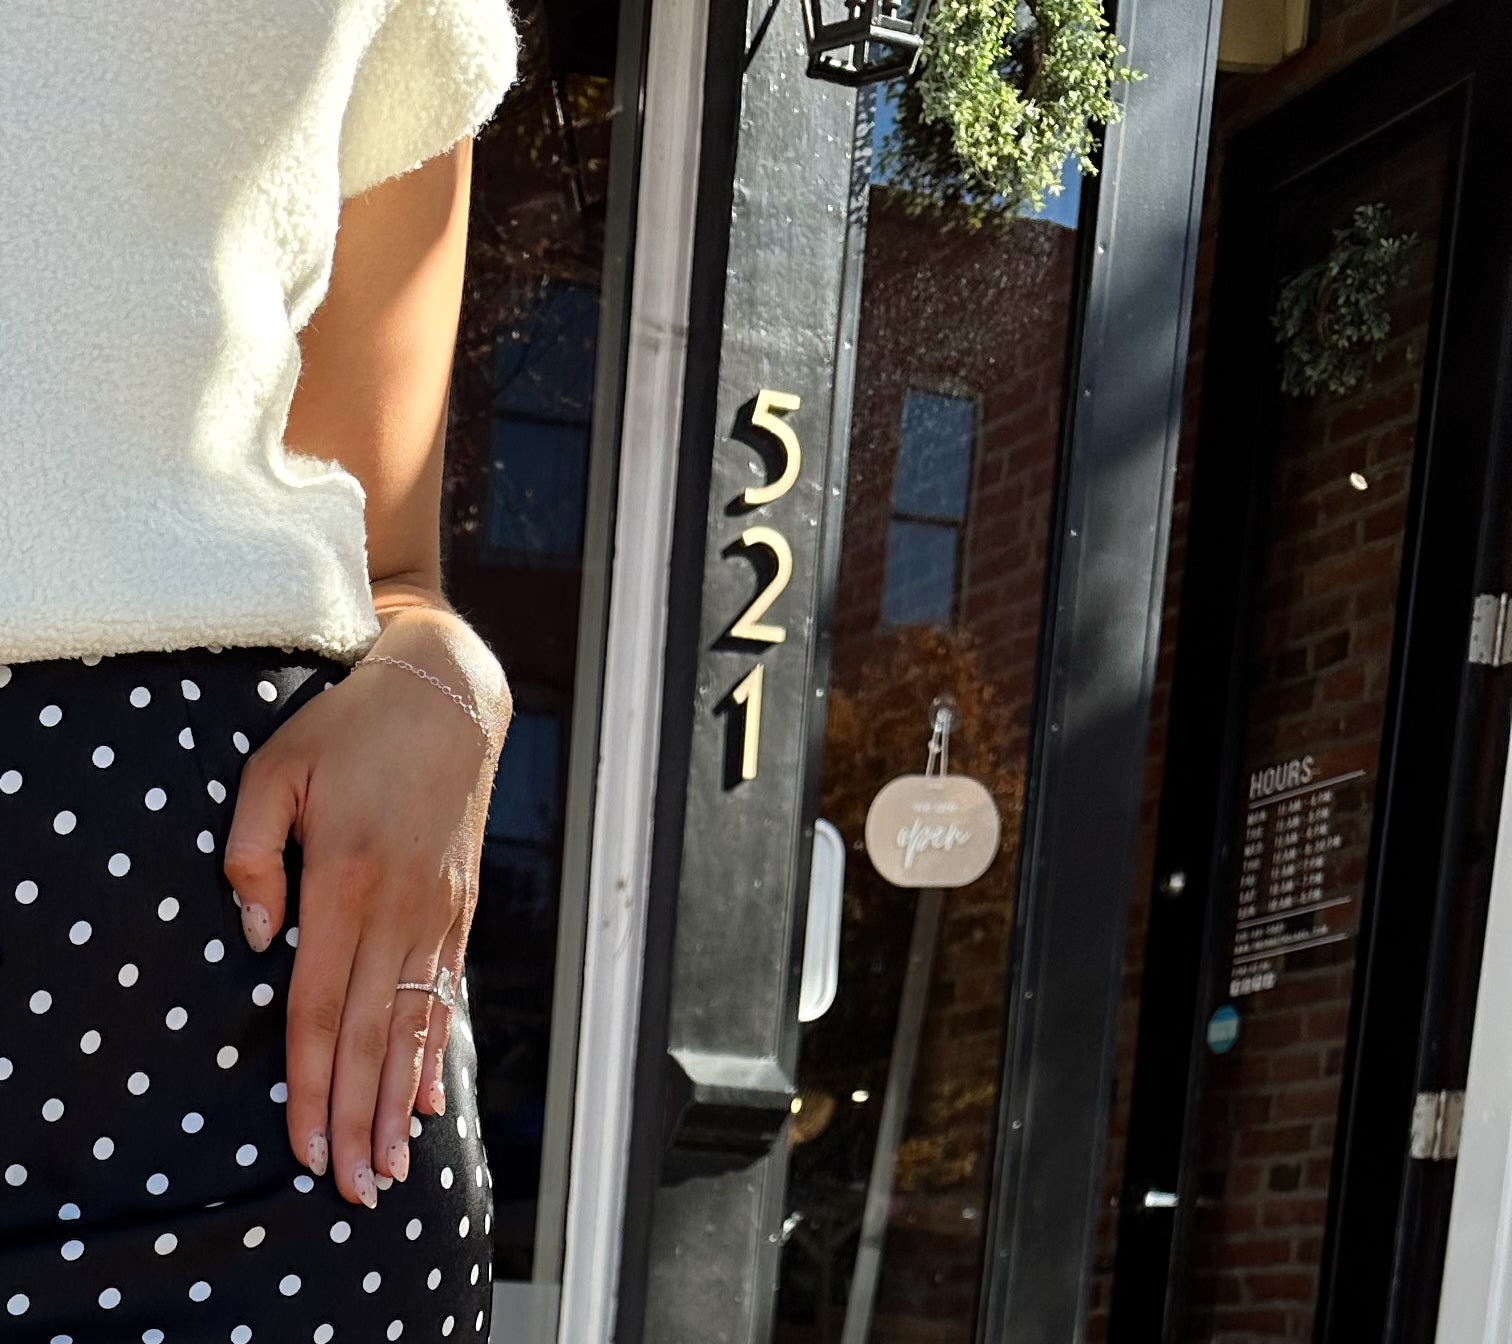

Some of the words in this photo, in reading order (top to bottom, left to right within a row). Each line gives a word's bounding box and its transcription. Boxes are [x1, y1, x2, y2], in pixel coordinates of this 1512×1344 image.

[730, 389, 801, 779] 521
[1249, 755, 1314, 799] HOURS
[896, 816, 972, 869] open
